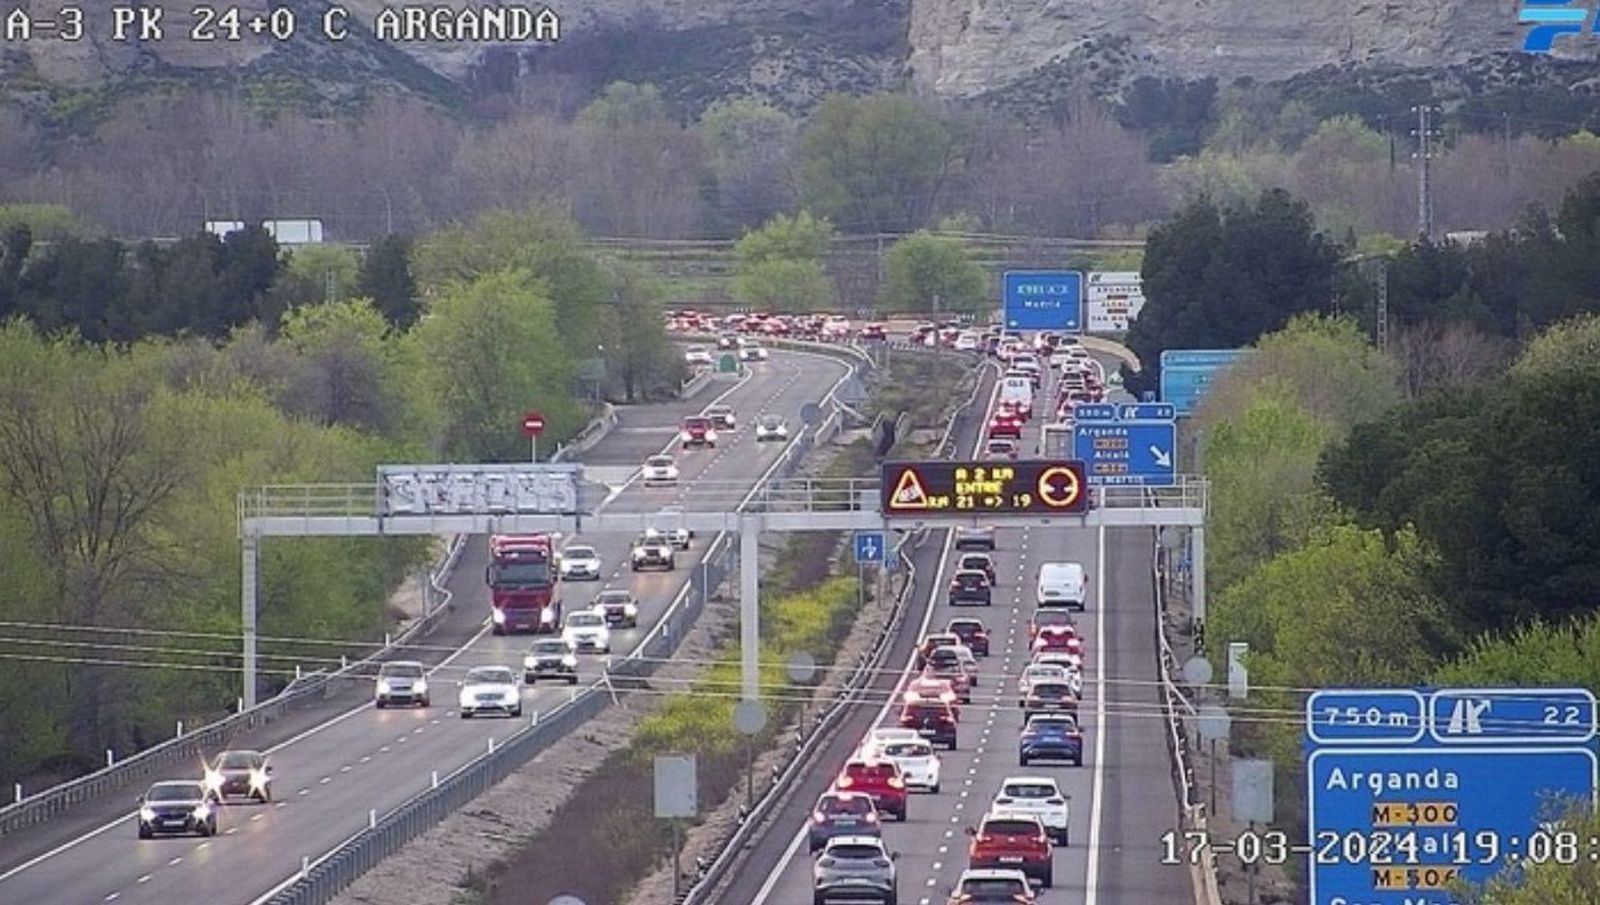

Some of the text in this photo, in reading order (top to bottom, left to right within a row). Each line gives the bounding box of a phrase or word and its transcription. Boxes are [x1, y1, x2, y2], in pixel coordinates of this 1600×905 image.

[974, 468, 986, 481] 2
[956, 481, 1003, 495] ENTRE
[956, 496, 974, 509] 21
[1012, 493, 1032, 507] 19
[1544, 706, 1581, 725] 22
[1326, 767, 1459, 797] Arganda
[1372, 805, 1458, 823] M-300
